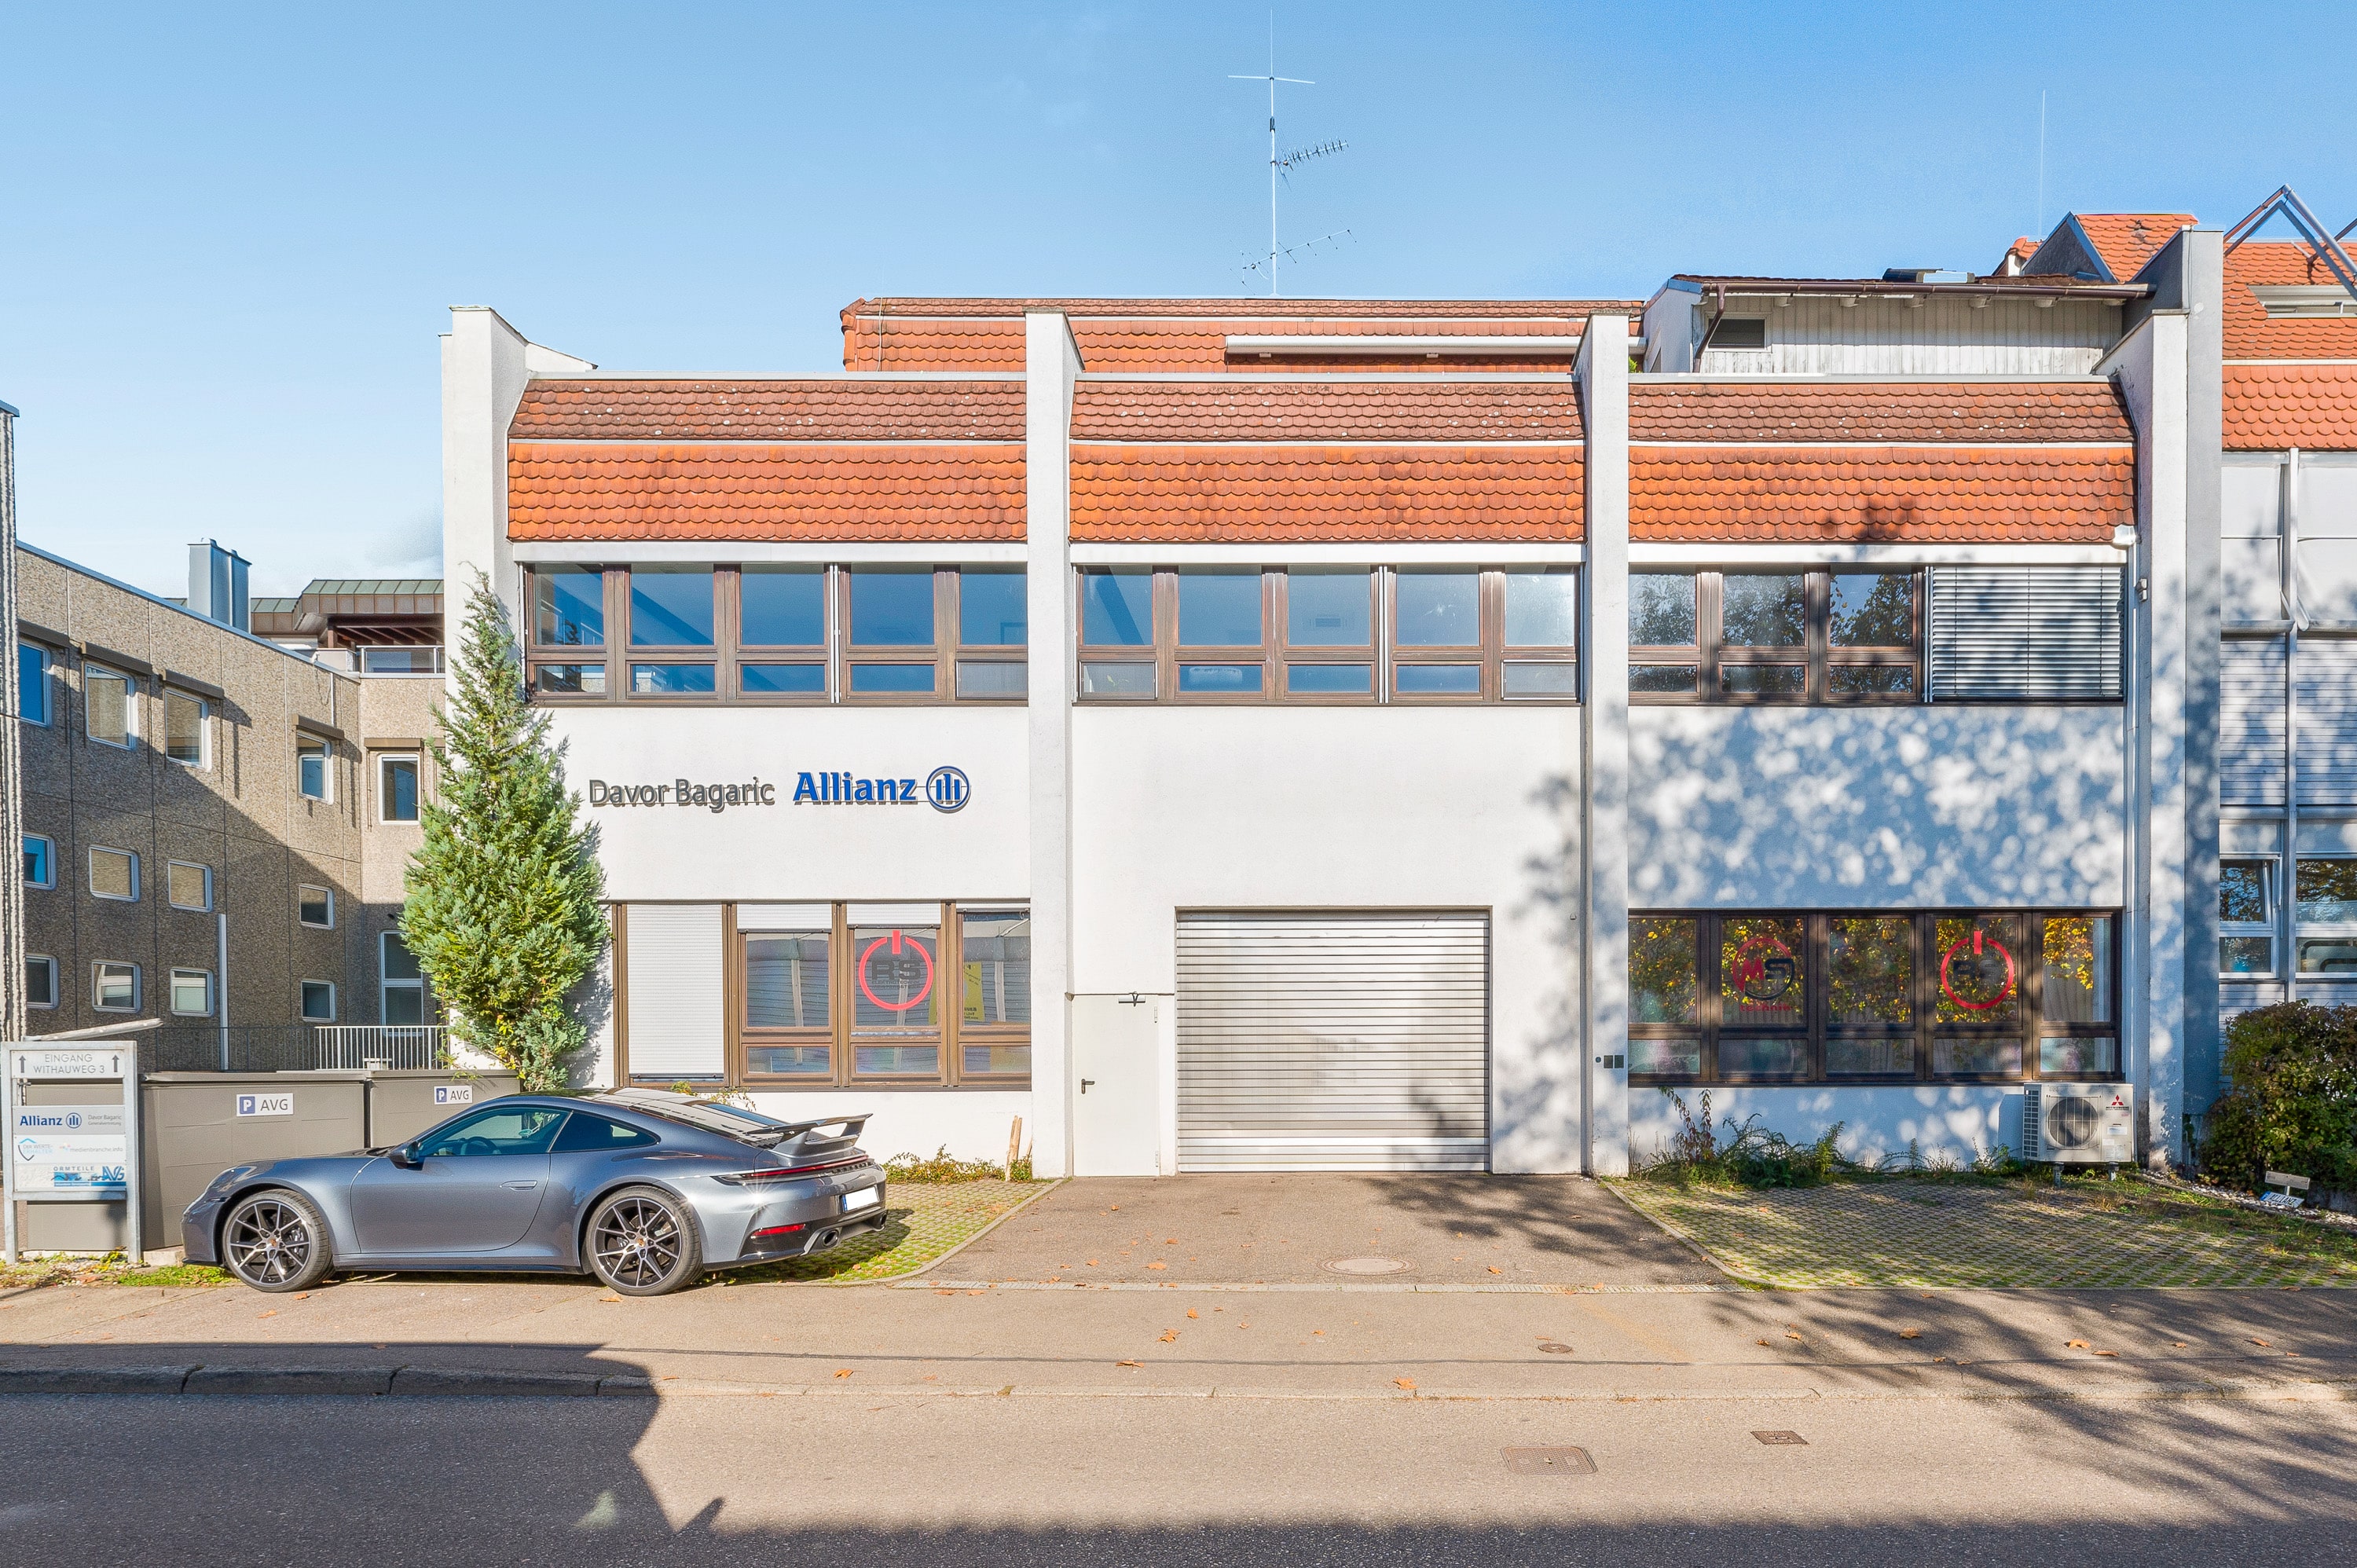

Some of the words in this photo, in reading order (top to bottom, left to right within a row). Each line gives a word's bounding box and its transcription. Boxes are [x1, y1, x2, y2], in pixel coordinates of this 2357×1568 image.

[588, 779, 669, 807] Davor
[674, 776, 776, 813] Bagaric
[793, 771, 918, 805] Allianz
[871, 960, 922, 980] RS
[44, 1053, 93, 1063] EINGANG
[33, 1064, 96, 1074] WITHAUWEG
[99, 1064, 105, 1074] 3
[449, 1090, 470, 1101] AVG
[260, 1099, 289, 1112] AVG
[20, 1115, 63, 1127] Allianz
[101, 1165, 125, 1181] AVG
